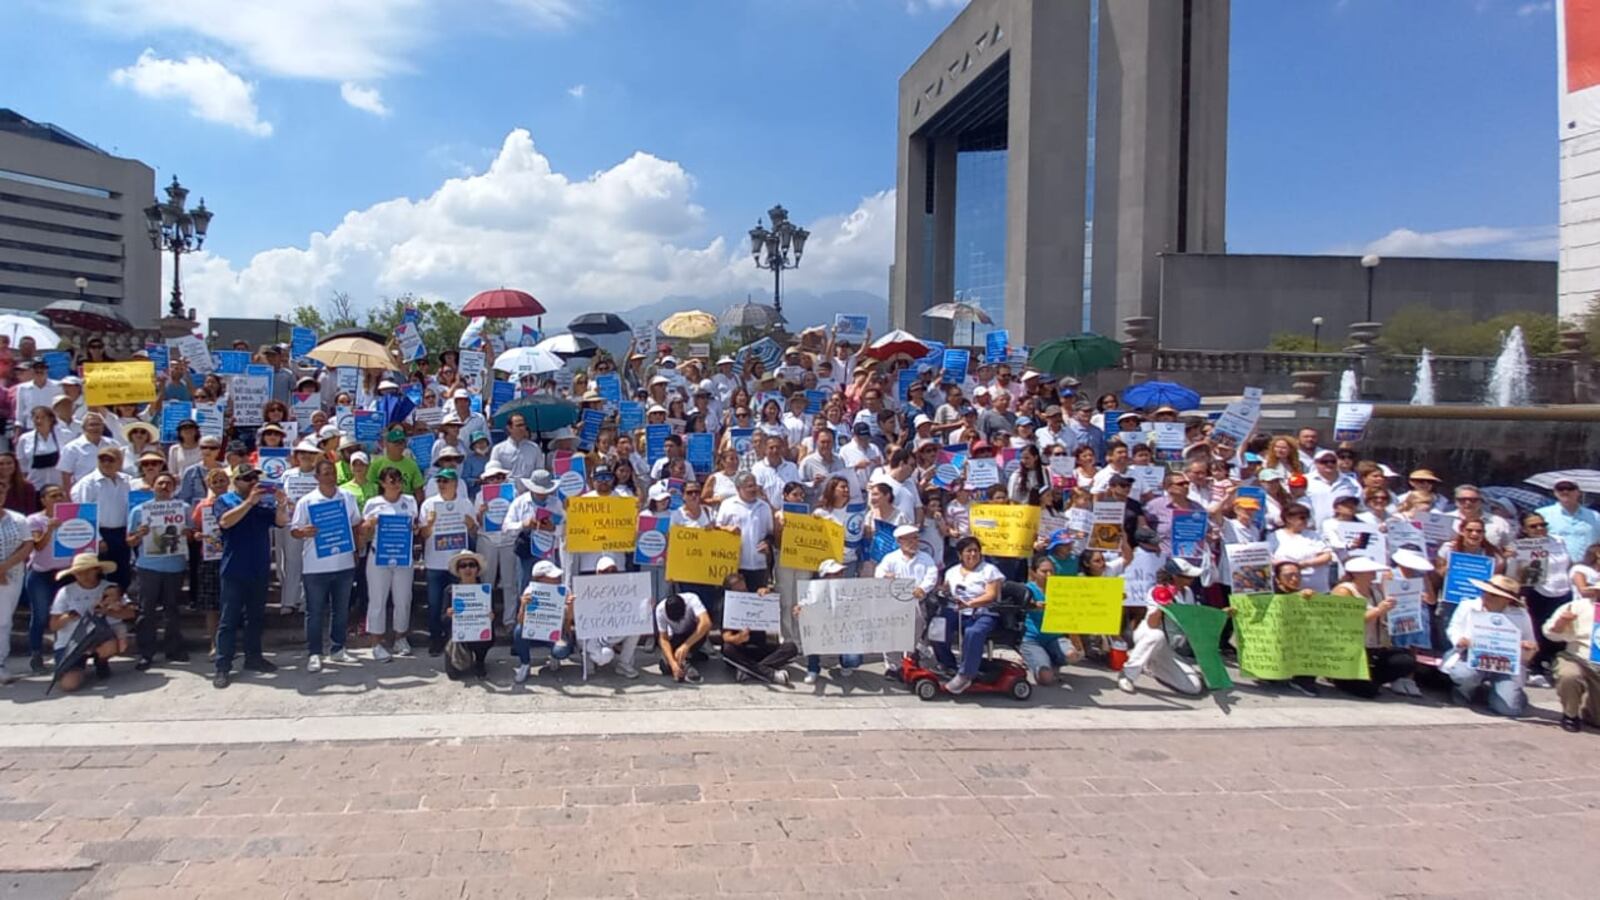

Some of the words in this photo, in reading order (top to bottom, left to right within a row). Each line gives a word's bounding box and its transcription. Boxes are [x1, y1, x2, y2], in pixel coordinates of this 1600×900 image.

[570, 502, 612, 514] SAMUEL
[164, 514, 184, 524] NO
[676, 530, 698, 540] CON
[686, 547, 703, 557] LOS
[581, 584, 638, 601] AGENDA
[599, 600, 633, 615] 2030
